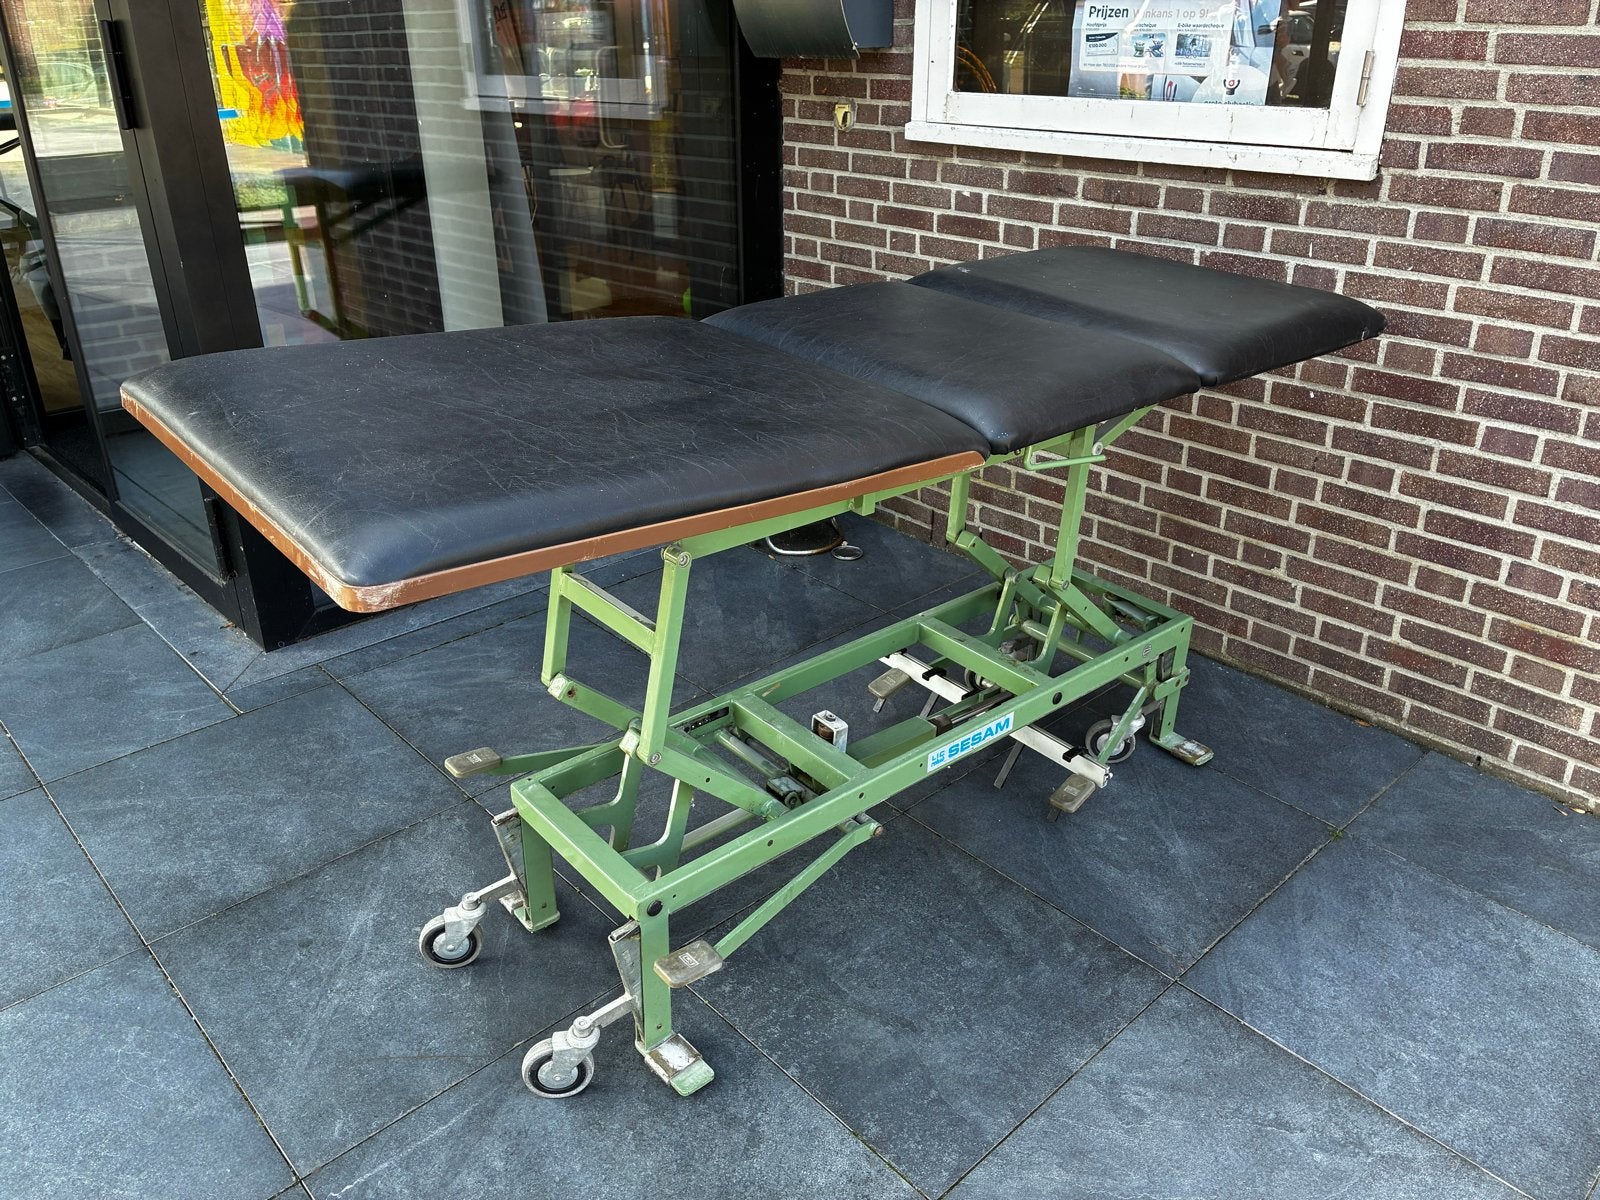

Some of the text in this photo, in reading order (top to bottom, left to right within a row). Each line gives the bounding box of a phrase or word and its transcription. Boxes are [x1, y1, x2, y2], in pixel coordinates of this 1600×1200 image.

[1088, 5, 1129, 20] Prijzen
[1175, 8, 1180, 18] 1
[1183, 10, 1196, 20] op
[1198, 8, 1209, 18] 9!
[948, 717, 1010, 758] SESAM
